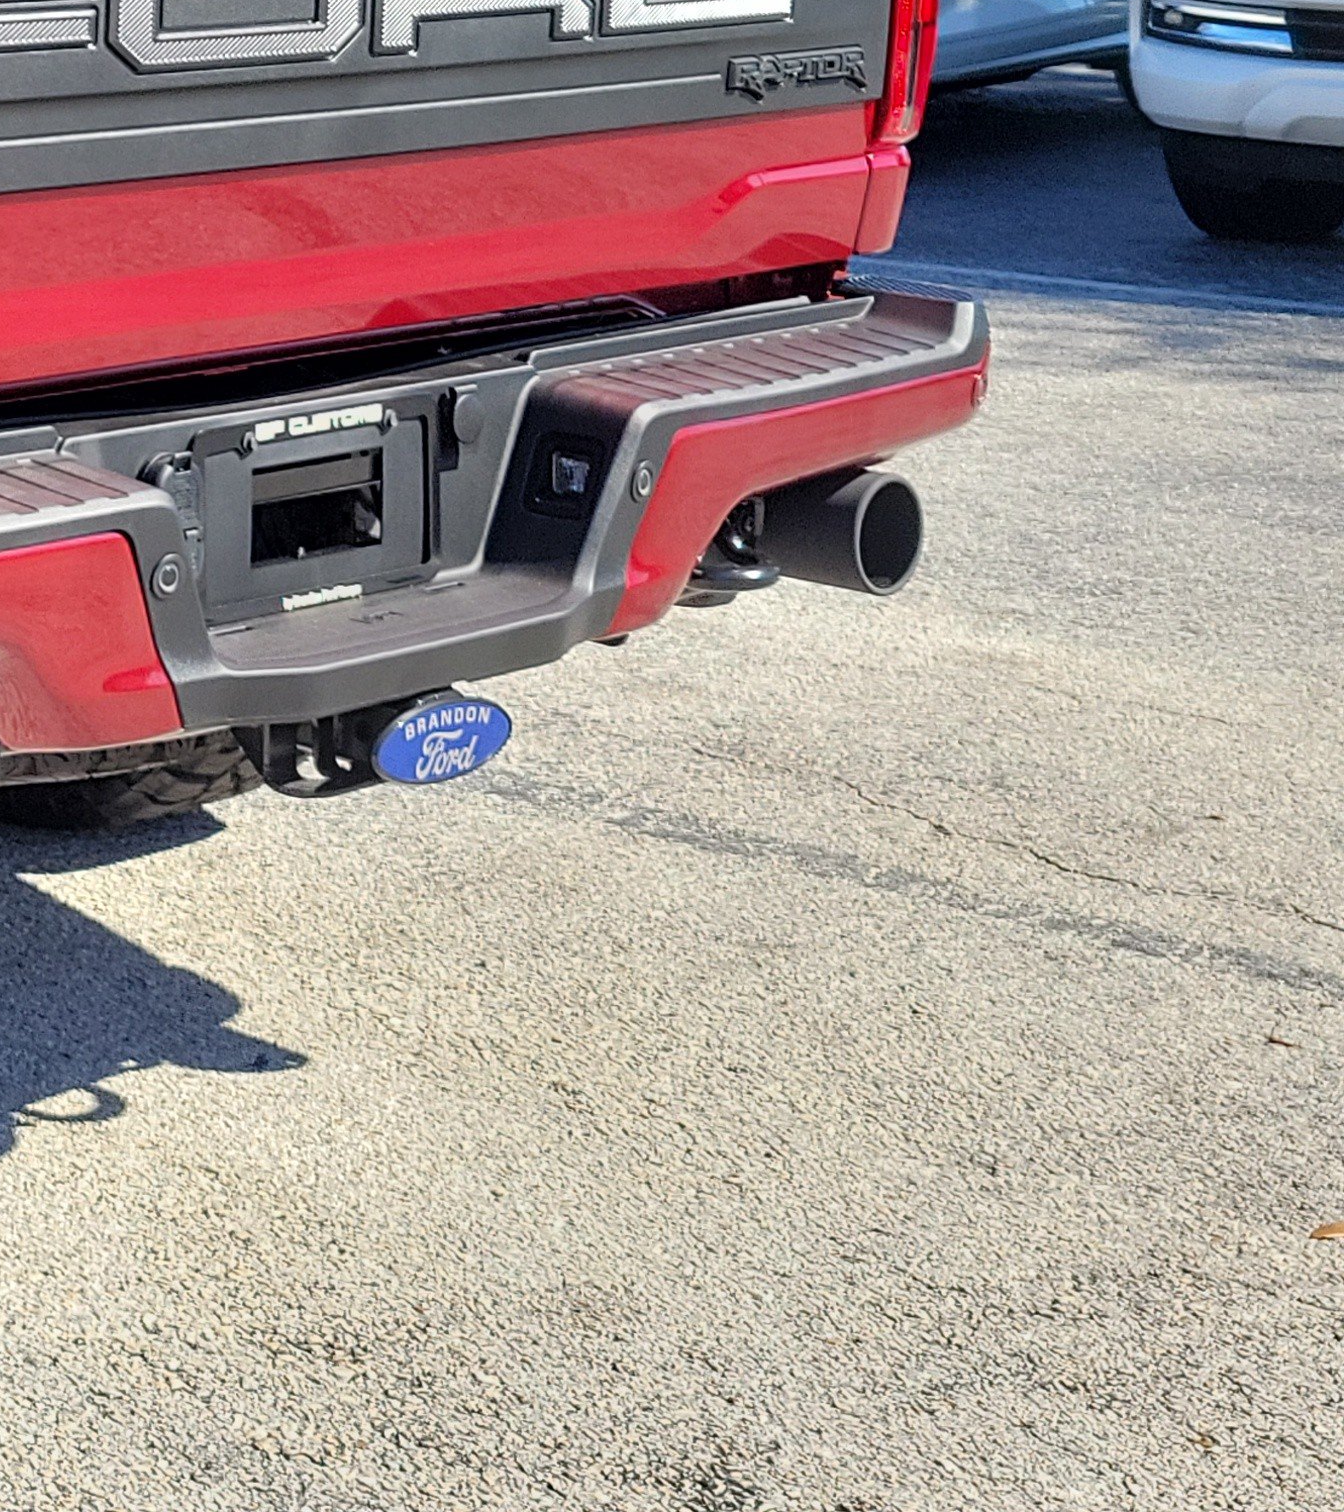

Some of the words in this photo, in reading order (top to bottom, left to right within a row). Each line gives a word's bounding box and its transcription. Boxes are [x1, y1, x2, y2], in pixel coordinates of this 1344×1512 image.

[725, 44, 868, 104] RAPTOR
[405, 705, 492, 741] BRANDON
[415, 728, 480, 780] Ford
